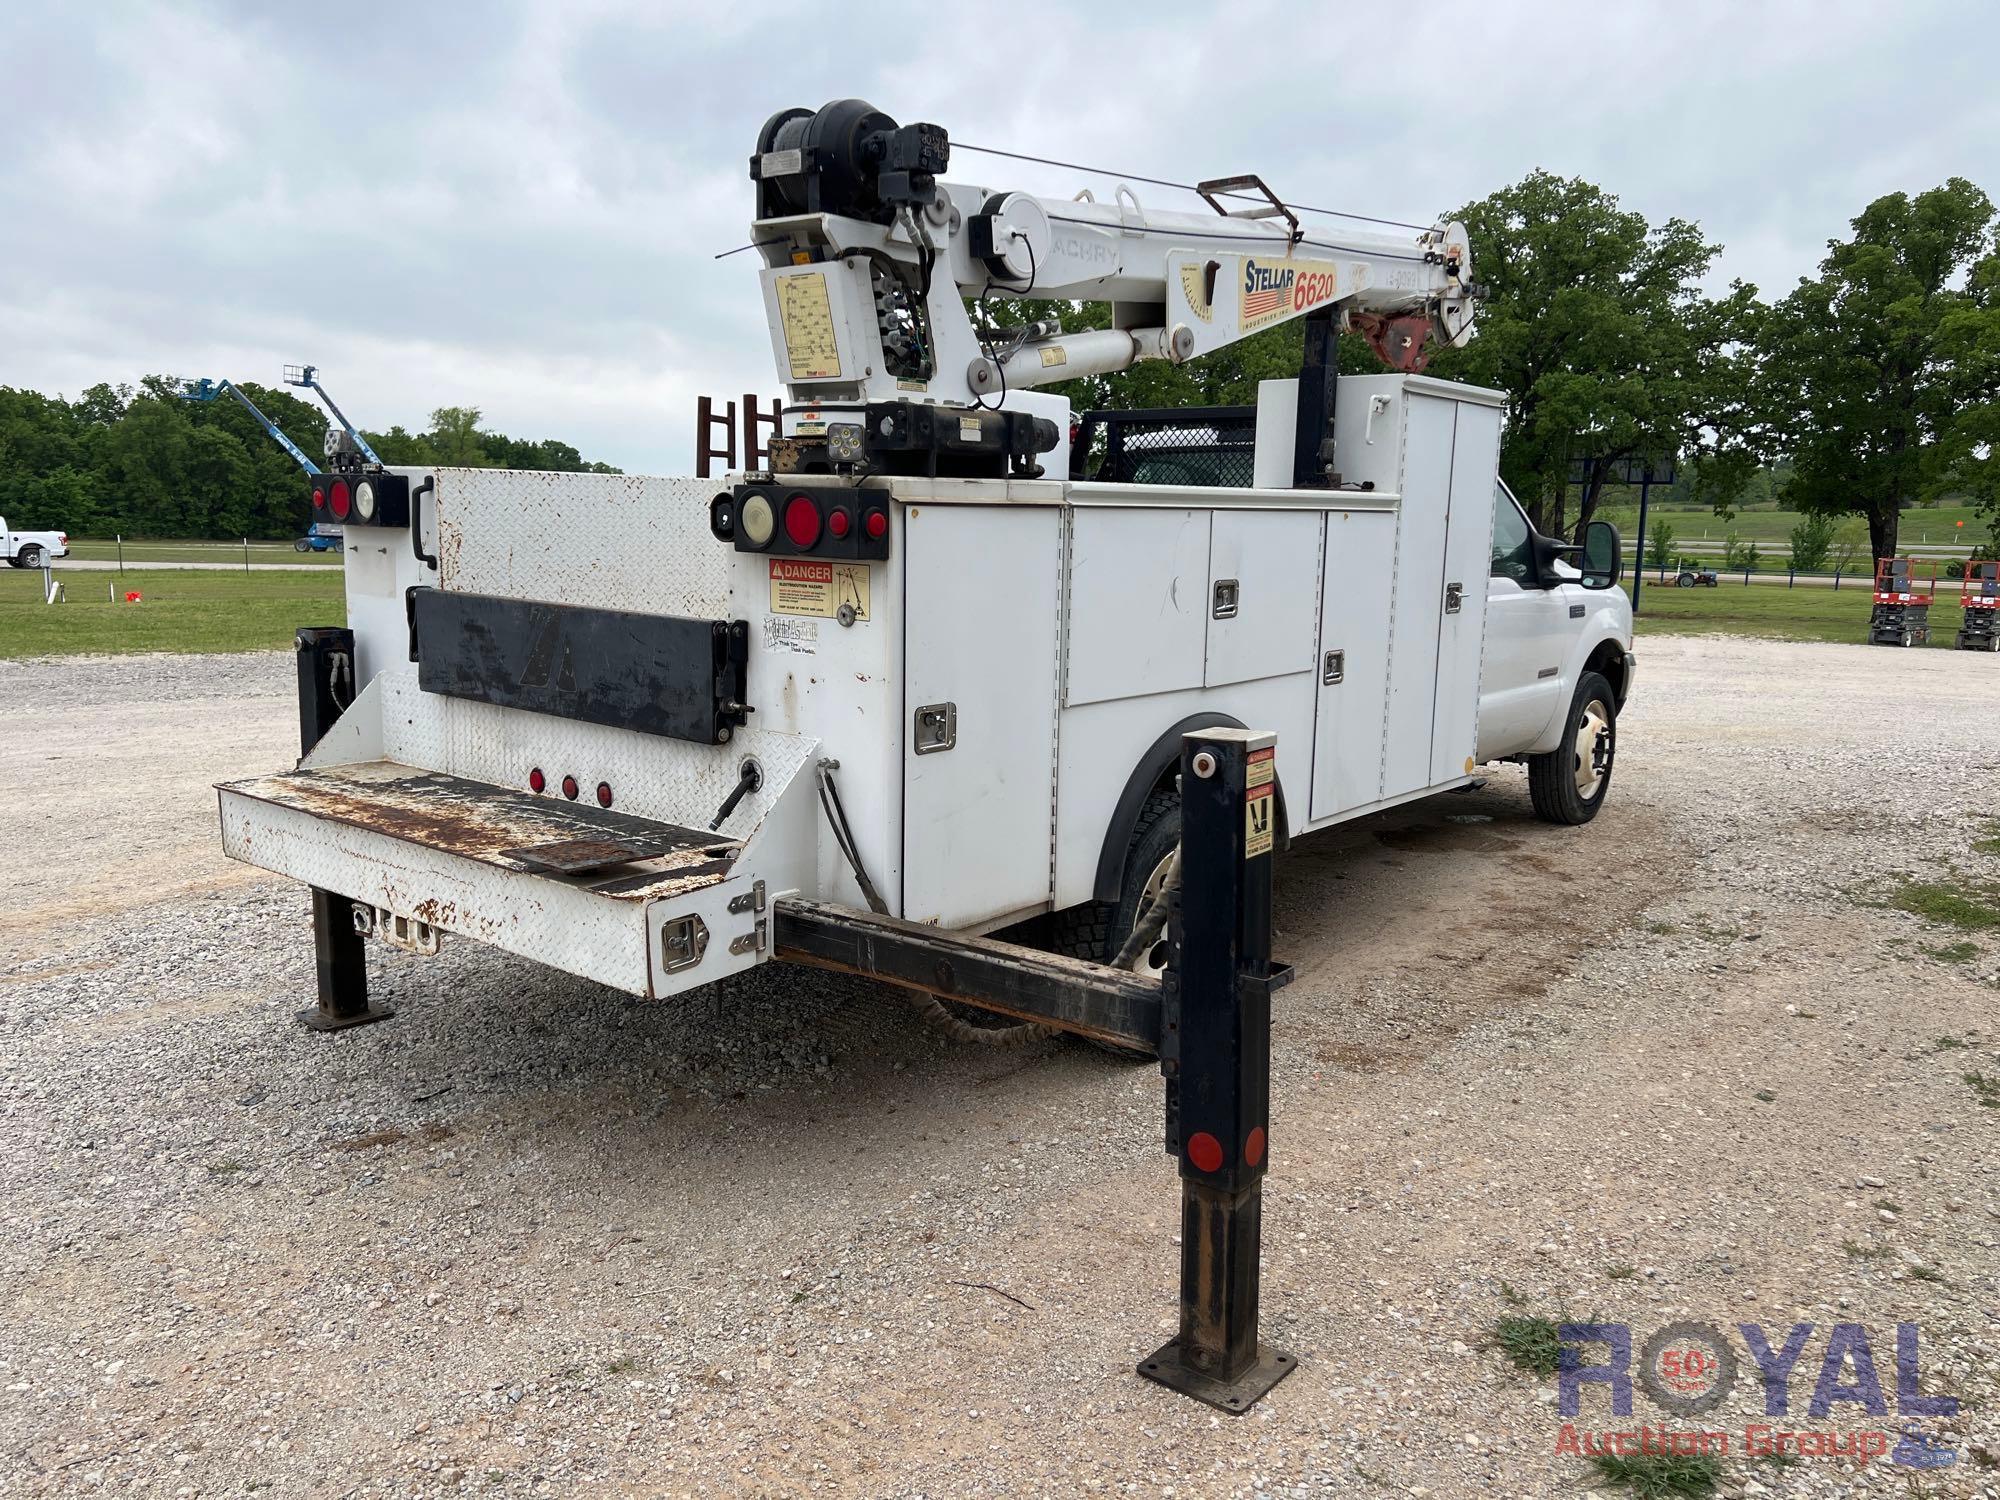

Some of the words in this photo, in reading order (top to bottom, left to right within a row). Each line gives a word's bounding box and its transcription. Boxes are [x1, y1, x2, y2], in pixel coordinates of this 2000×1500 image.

[1245, 260, 1294, 293] STELLAR
[1294, 271, 1333, 311] 6620
[1243, 313, 1277, 331] INDUSTRIES
[275, 433, 290, 449] Genie
[785, 565, 831, 580] DANGER
